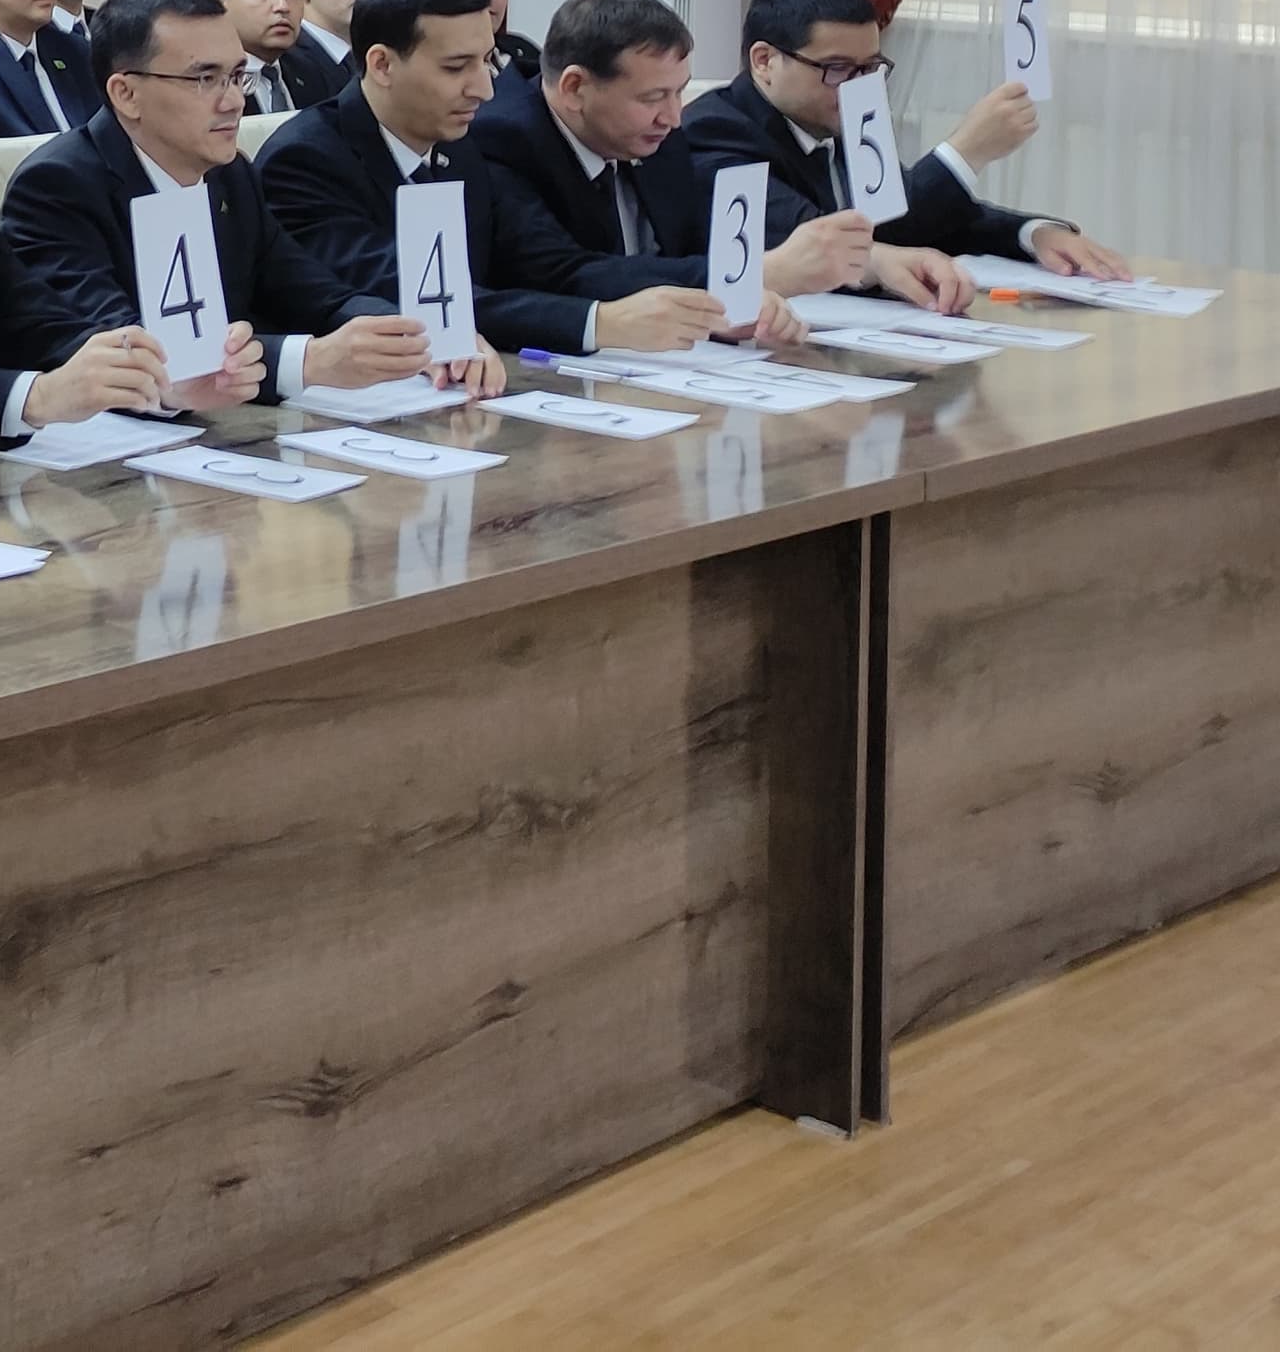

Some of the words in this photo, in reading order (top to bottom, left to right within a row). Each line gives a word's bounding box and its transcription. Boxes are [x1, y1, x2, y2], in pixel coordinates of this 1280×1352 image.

[859, 109, 887, 196] 5
[159, 232, 206, 340] 4
[416, 229, 454, 330] 4
[723, 193, 751, 285] 3
